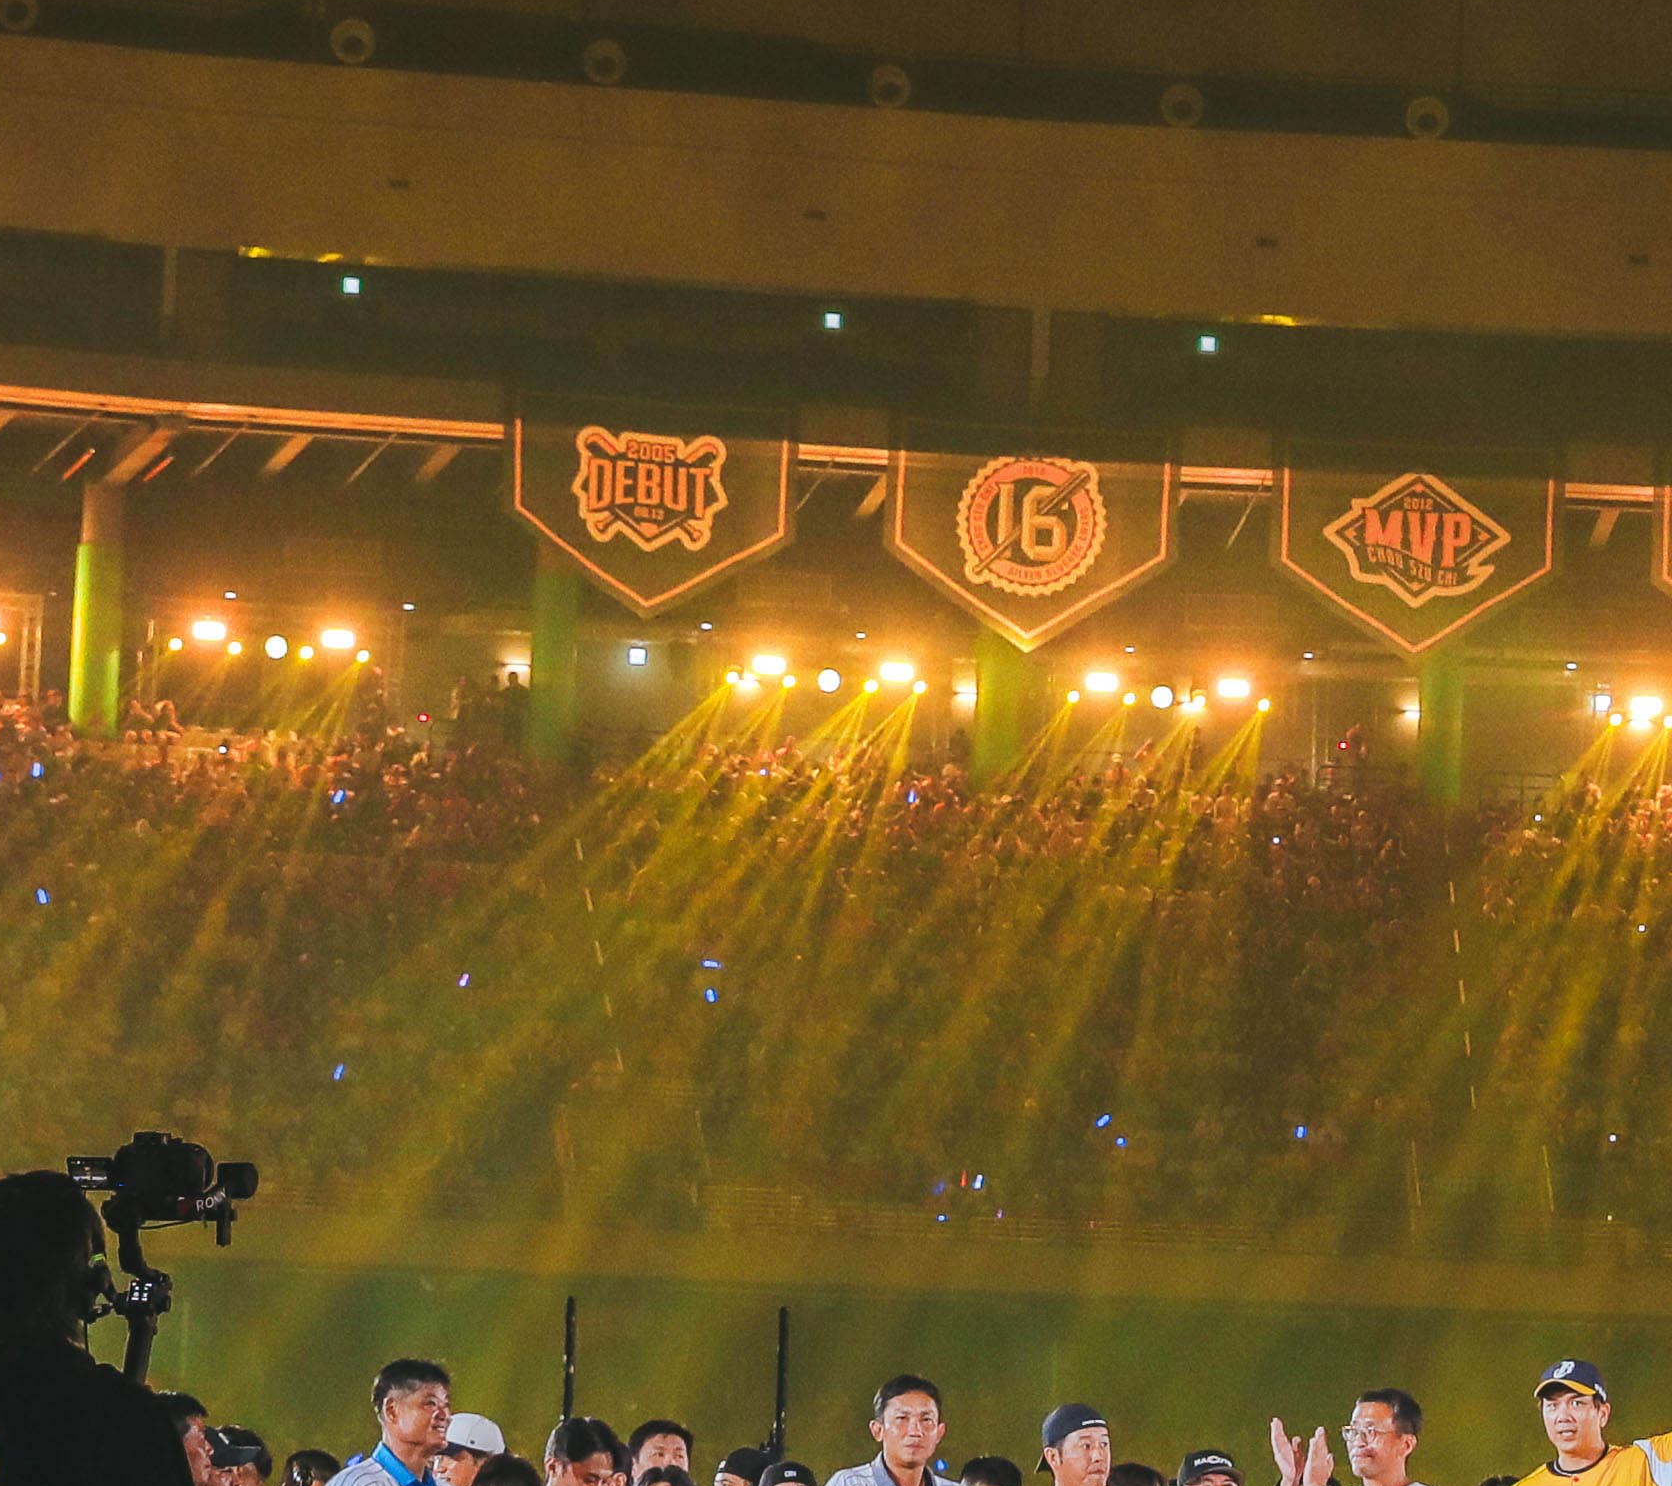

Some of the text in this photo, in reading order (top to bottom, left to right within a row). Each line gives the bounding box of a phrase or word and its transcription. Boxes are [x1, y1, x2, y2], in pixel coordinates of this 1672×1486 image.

[626, 439, 677, 464] 2005
[587, 456, 714, 519] DEBUT
[997, 482, 1067, 562] 16
[1364, 507, 1472, 568] MVP
